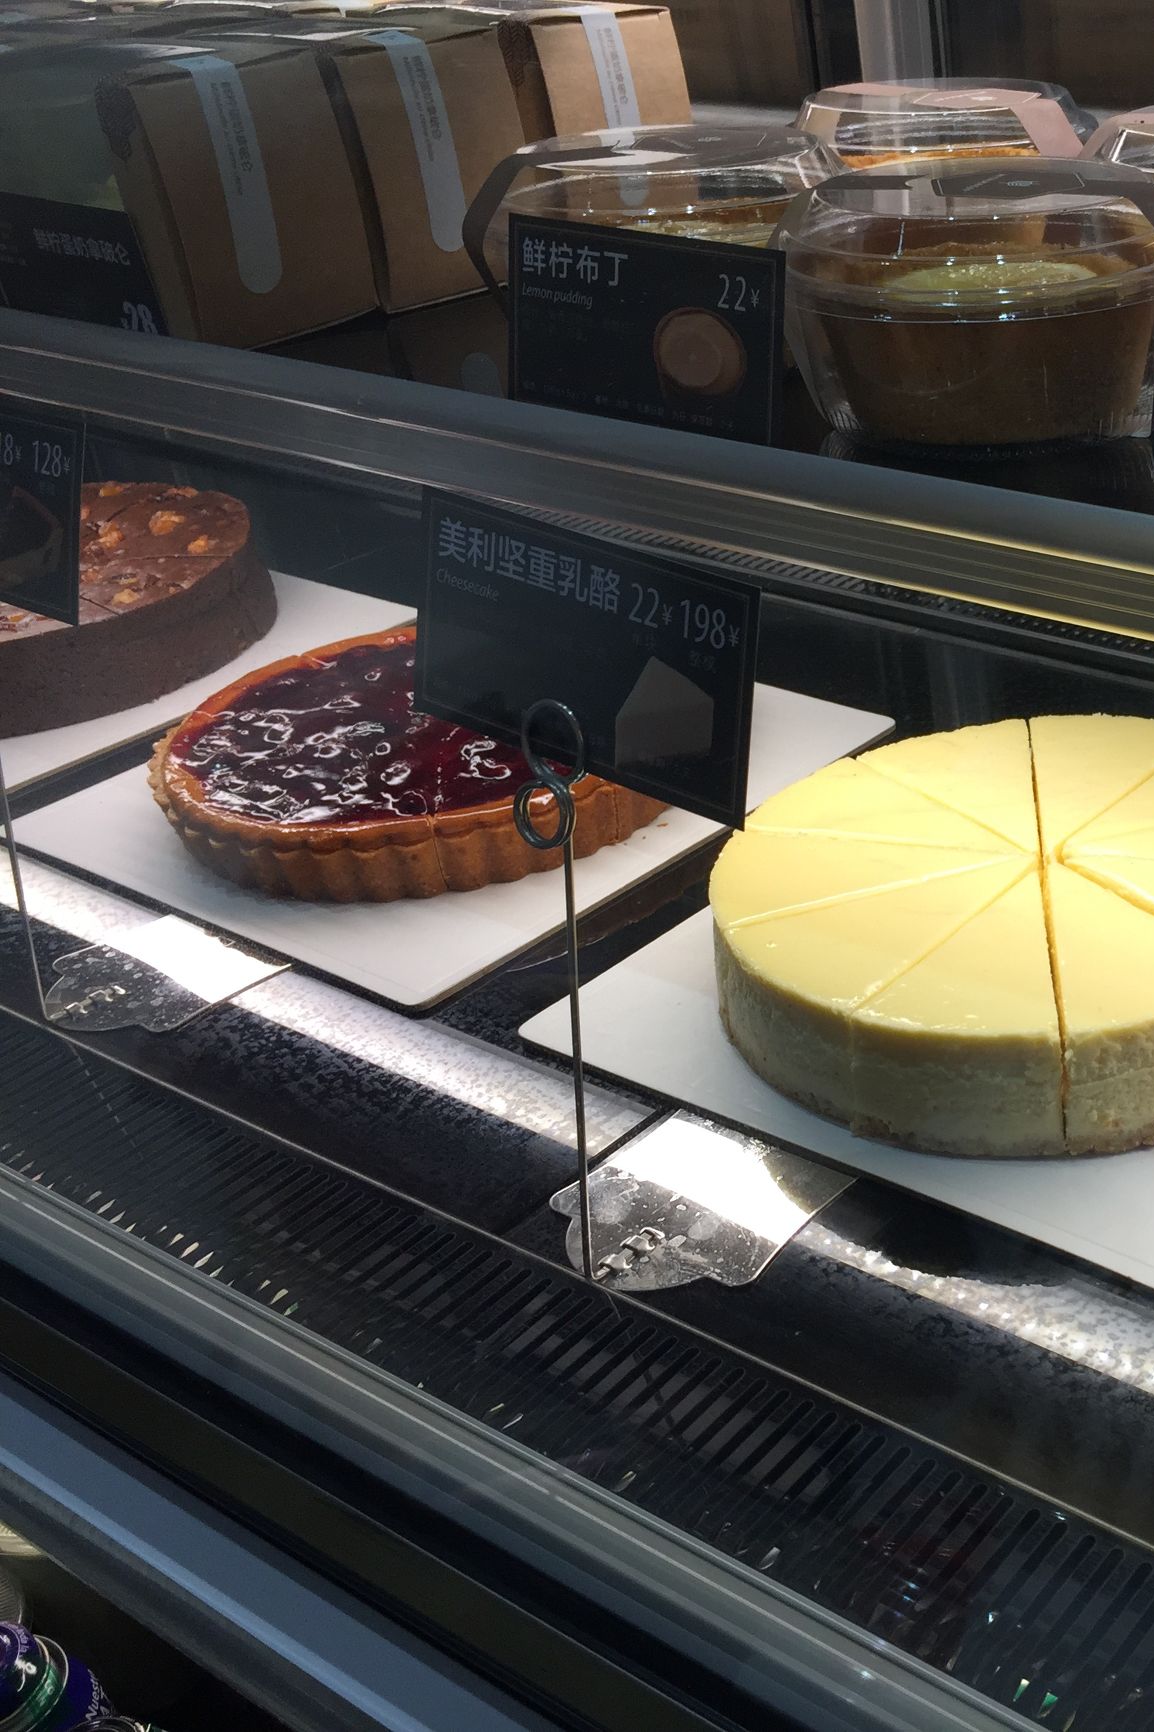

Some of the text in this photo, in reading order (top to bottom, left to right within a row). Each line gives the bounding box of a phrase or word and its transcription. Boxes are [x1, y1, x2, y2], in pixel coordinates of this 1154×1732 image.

[522, 236, 629, 287] 鲜柠布丁
[521, 281, 594, 310] Lemon pudding
[0, 432, 22, 466] 8¥
[437, 516, 621, 615] 美利坚重乳酪
[436, 567, 500, 602] Cheesecake
